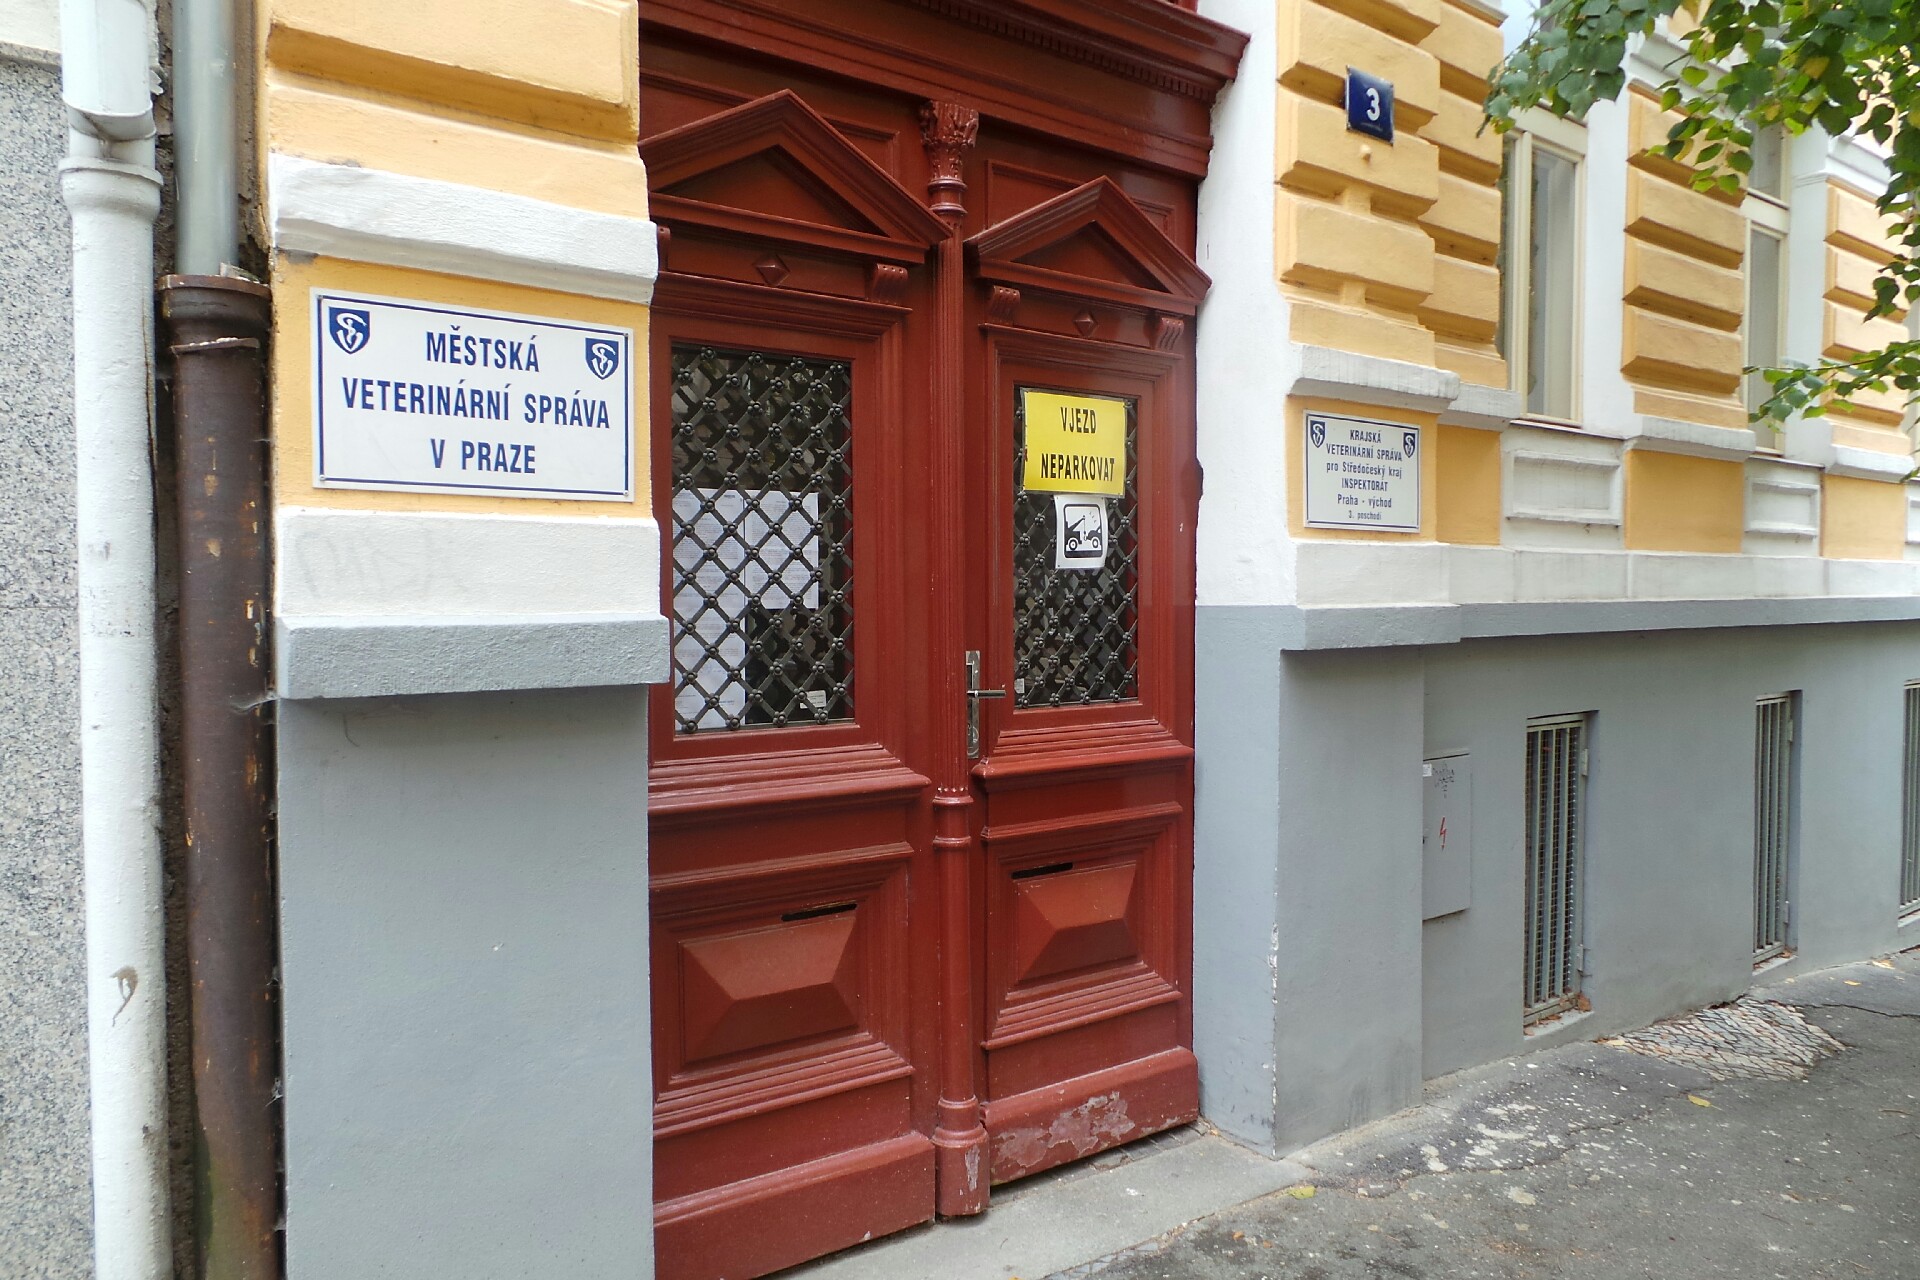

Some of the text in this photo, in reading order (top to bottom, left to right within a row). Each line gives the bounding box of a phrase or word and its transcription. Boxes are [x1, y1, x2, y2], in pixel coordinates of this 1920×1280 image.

[1366, 87, 1380, 121] 3
[426, 324, 540, 373] MĚSTSKÁ
[342, 376, 610, 429] VETERINÁRNÍ SPRÁVA
[1060, 406, 1097, 434] VJEZD
[1349, 429, 1382, 443] KRAJSKÁ
[430, 438, 537, 474] V PRAZE
[1326, 443, 1403, 461] VETERINÁRNÍ SPRÁVA
[1041, 453, 1115, 482] NEPARKOVAT
[1326, 461, 1402, 479] pro Středočeský kraj
[1337, 493, 1359, 506] Praha
[1368, 497, 1392, 508] východ
[1357, 511, 1382, 520] poschodí
